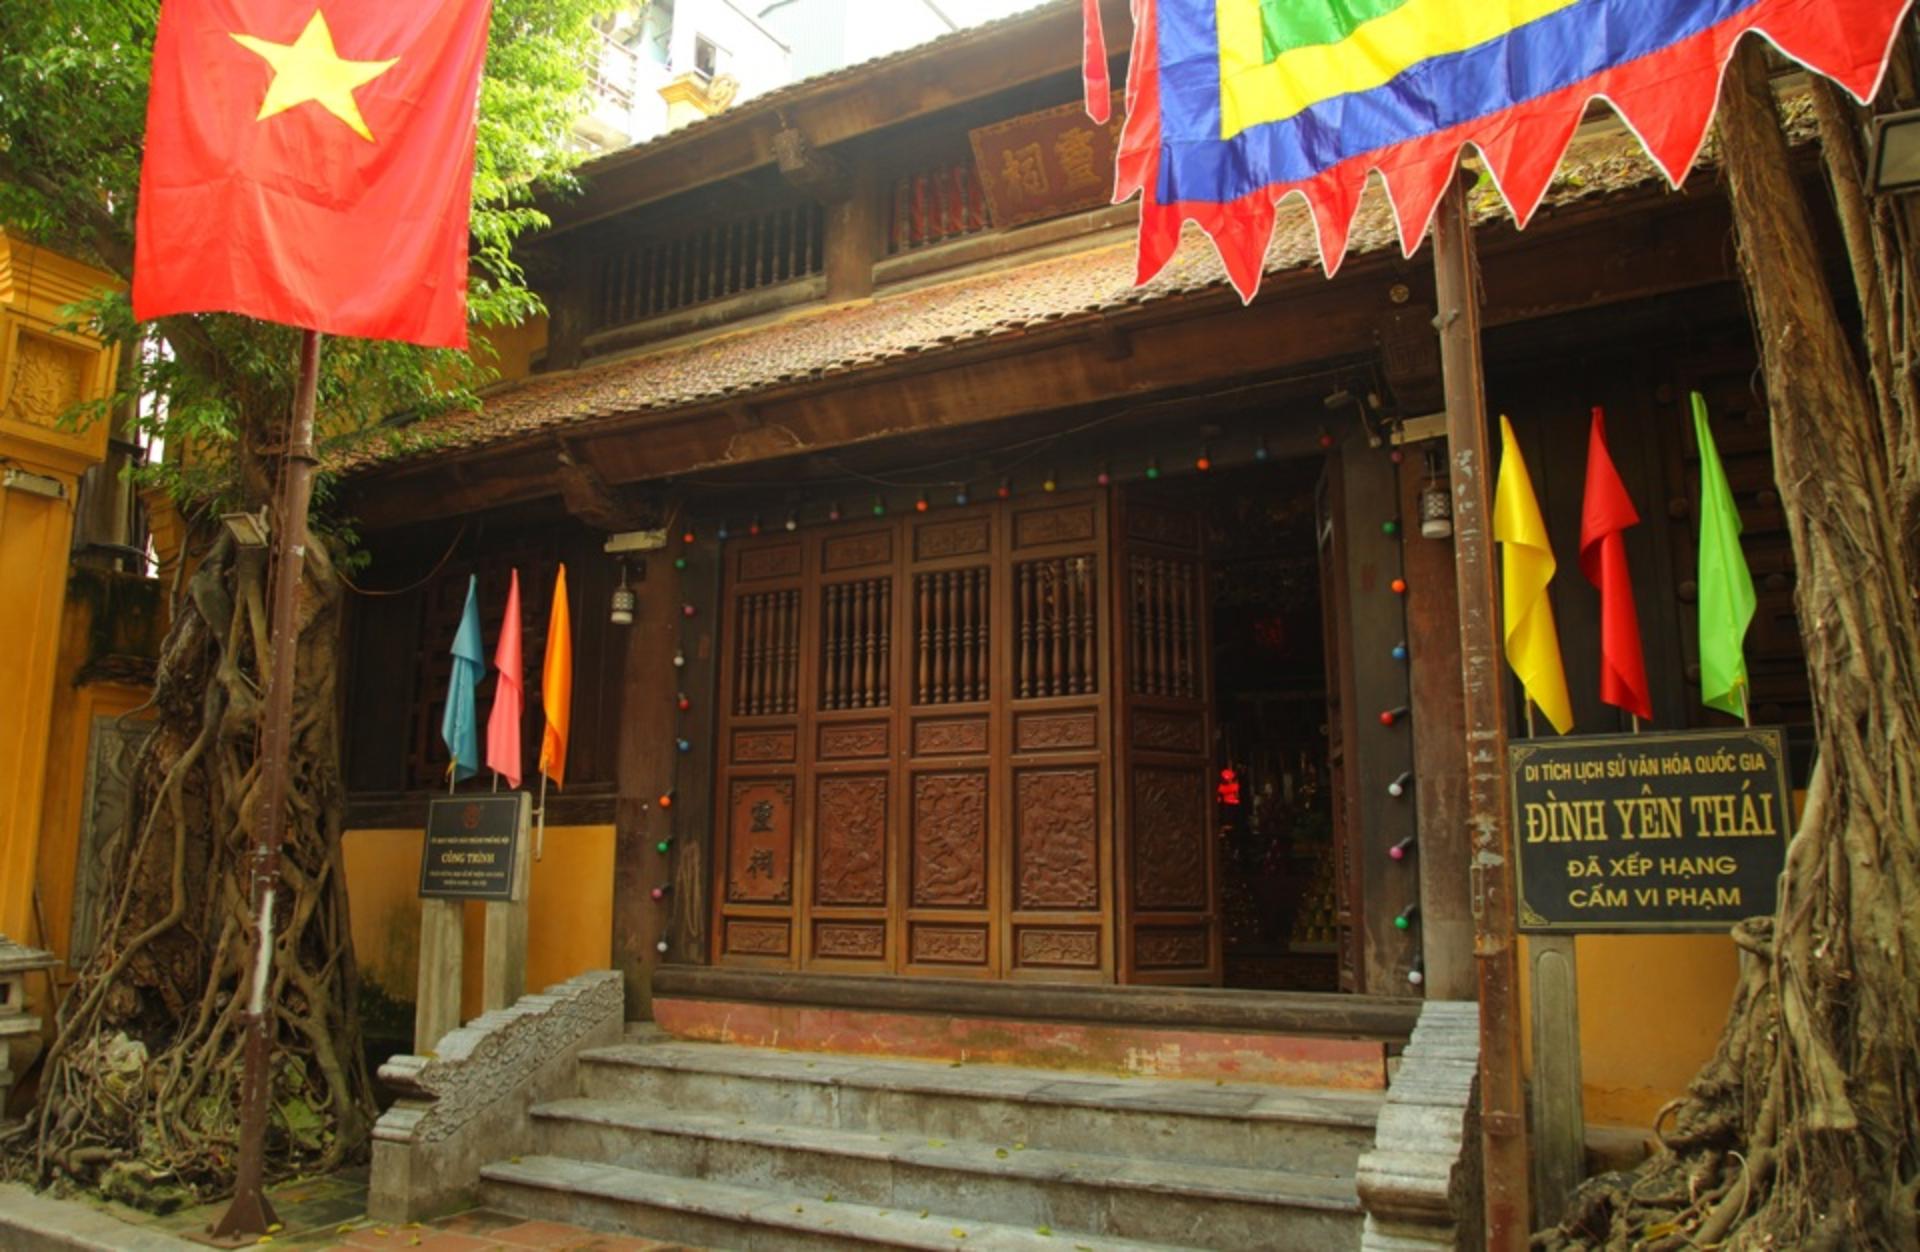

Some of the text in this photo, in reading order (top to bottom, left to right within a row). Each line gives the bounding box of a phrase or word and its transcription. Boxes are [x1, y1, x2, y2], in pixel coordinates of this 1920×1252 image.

[1525, 746, 1766, 784] DI TÍCH LỊCH SỬ VĂN HÓA QUỐC GIA
[1524, 779, 1776, 843] ĐÌNH YÊN THÁI
[1567, 851, 1738, 879] ĐÃ XẾP HẠNG
[1568, 883, 1741, 910] CẤM VI PHẠM
